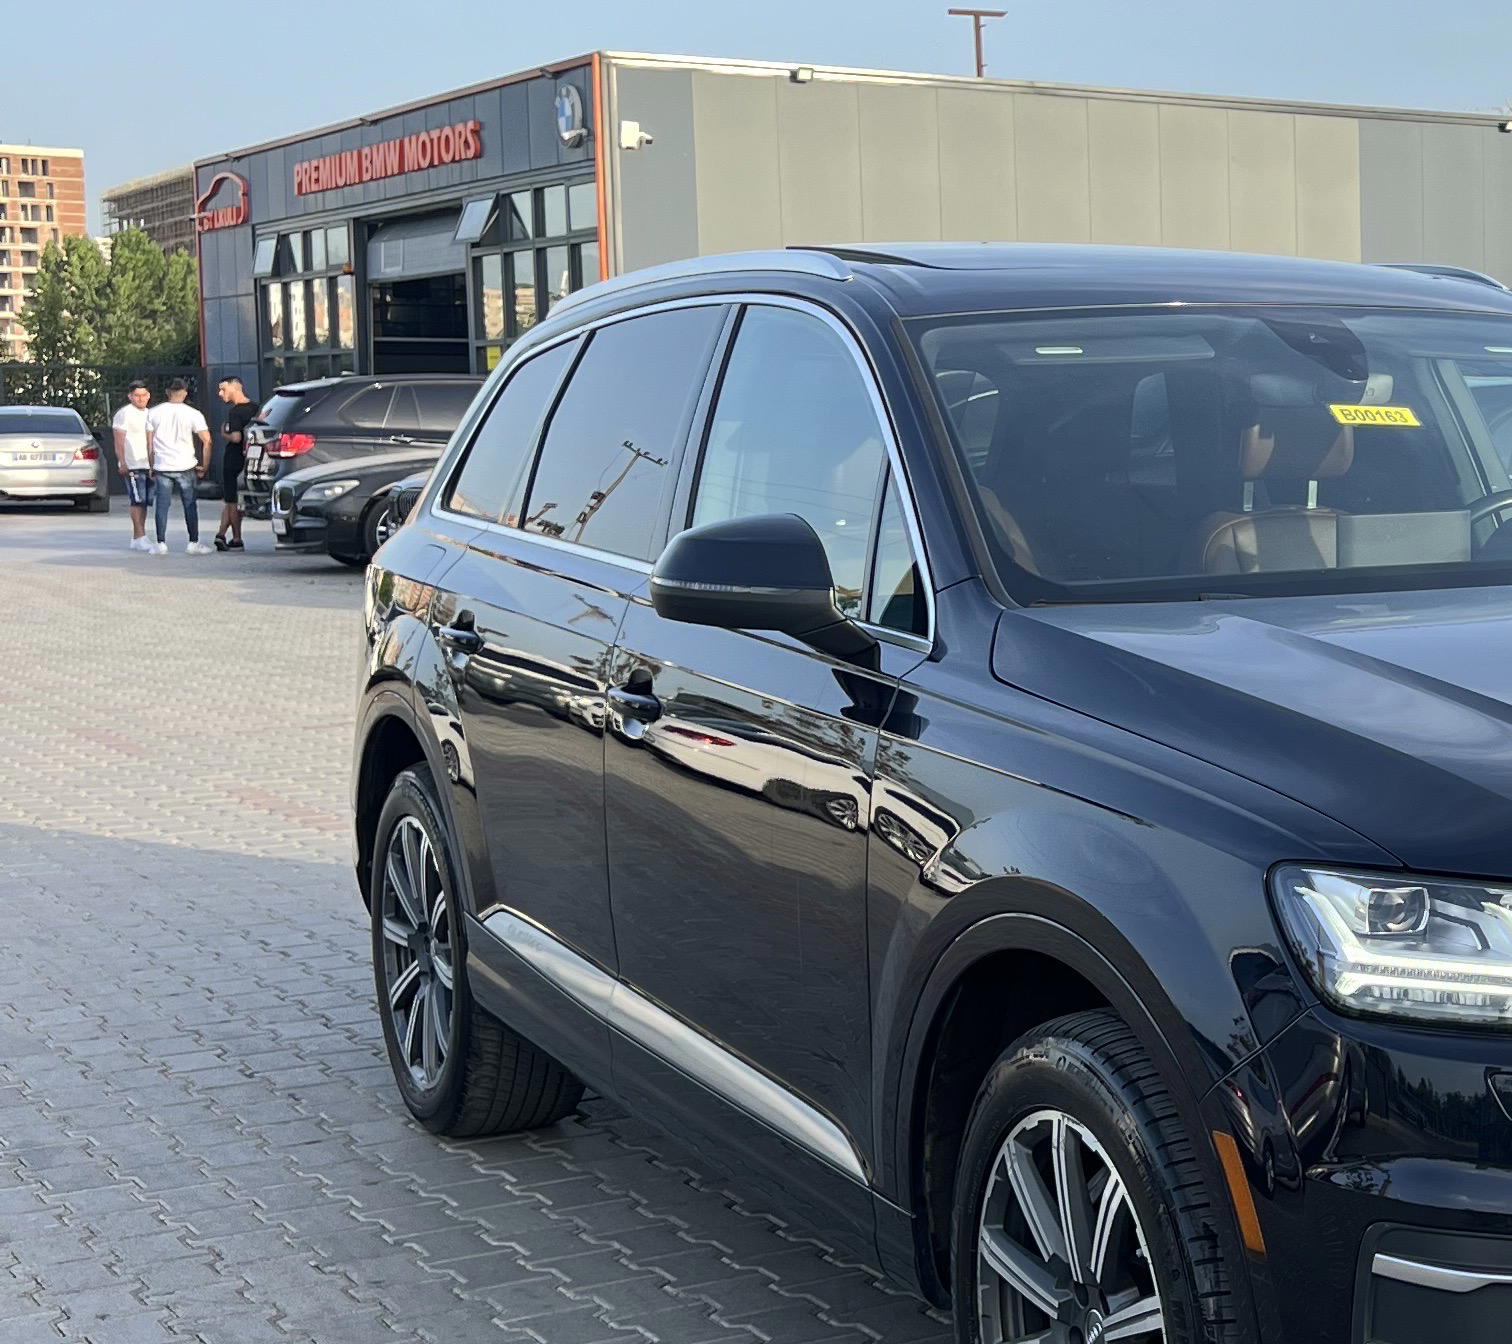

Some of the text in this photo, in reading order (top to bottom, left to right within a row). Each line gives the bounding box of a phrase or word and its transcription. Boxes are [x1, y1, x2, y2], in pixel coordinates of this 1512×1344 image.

[293, 119, 481, 196] PREMIUM BMW MOTORS
[1339, 408, 1409, 423] B00163
